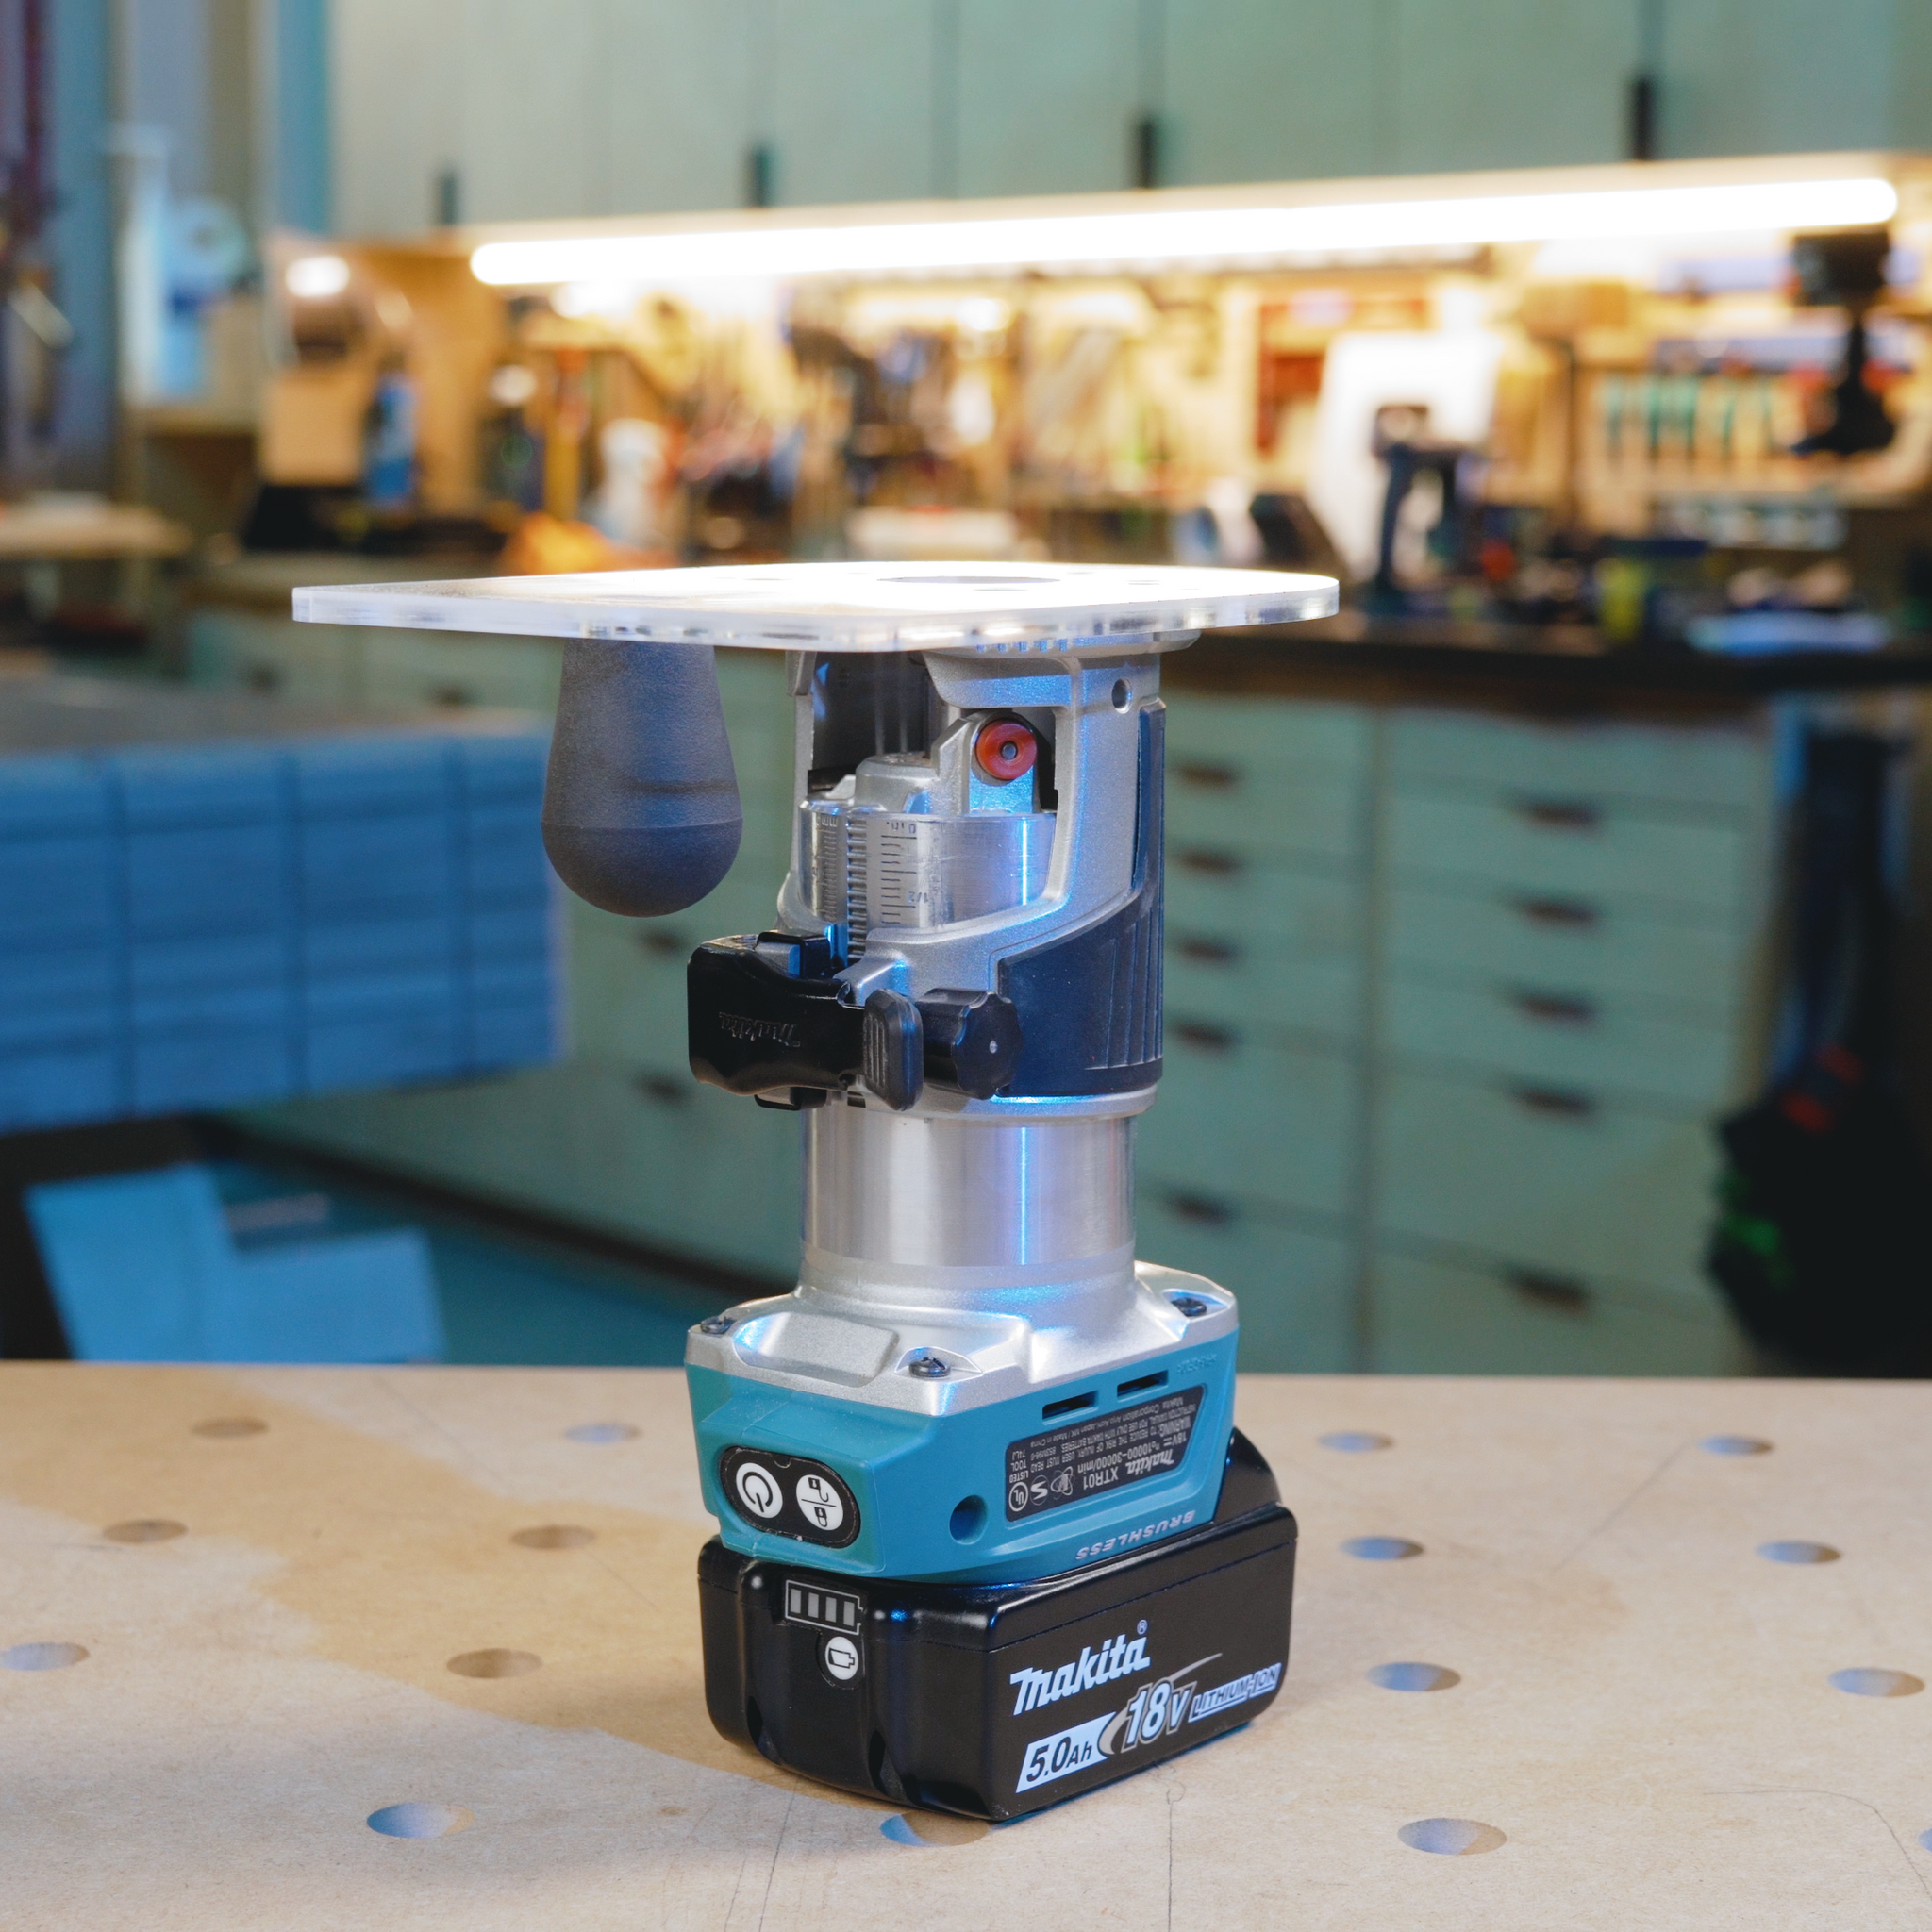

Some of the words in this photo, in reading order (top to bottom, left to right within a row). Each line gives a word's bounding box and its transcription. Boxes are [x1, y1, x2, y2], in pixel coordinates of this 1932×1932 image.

[1008, 1469, 1028, 1483] LISTED
[1010, 1457, 1026, 1472] TOOL
[1083, 1465, 1118, 1490] XTR01
[1075, 1510, 1196, 1560] BRUSHLESS
[1191, 1664, 1281, 1721] LITHIUM-ION
